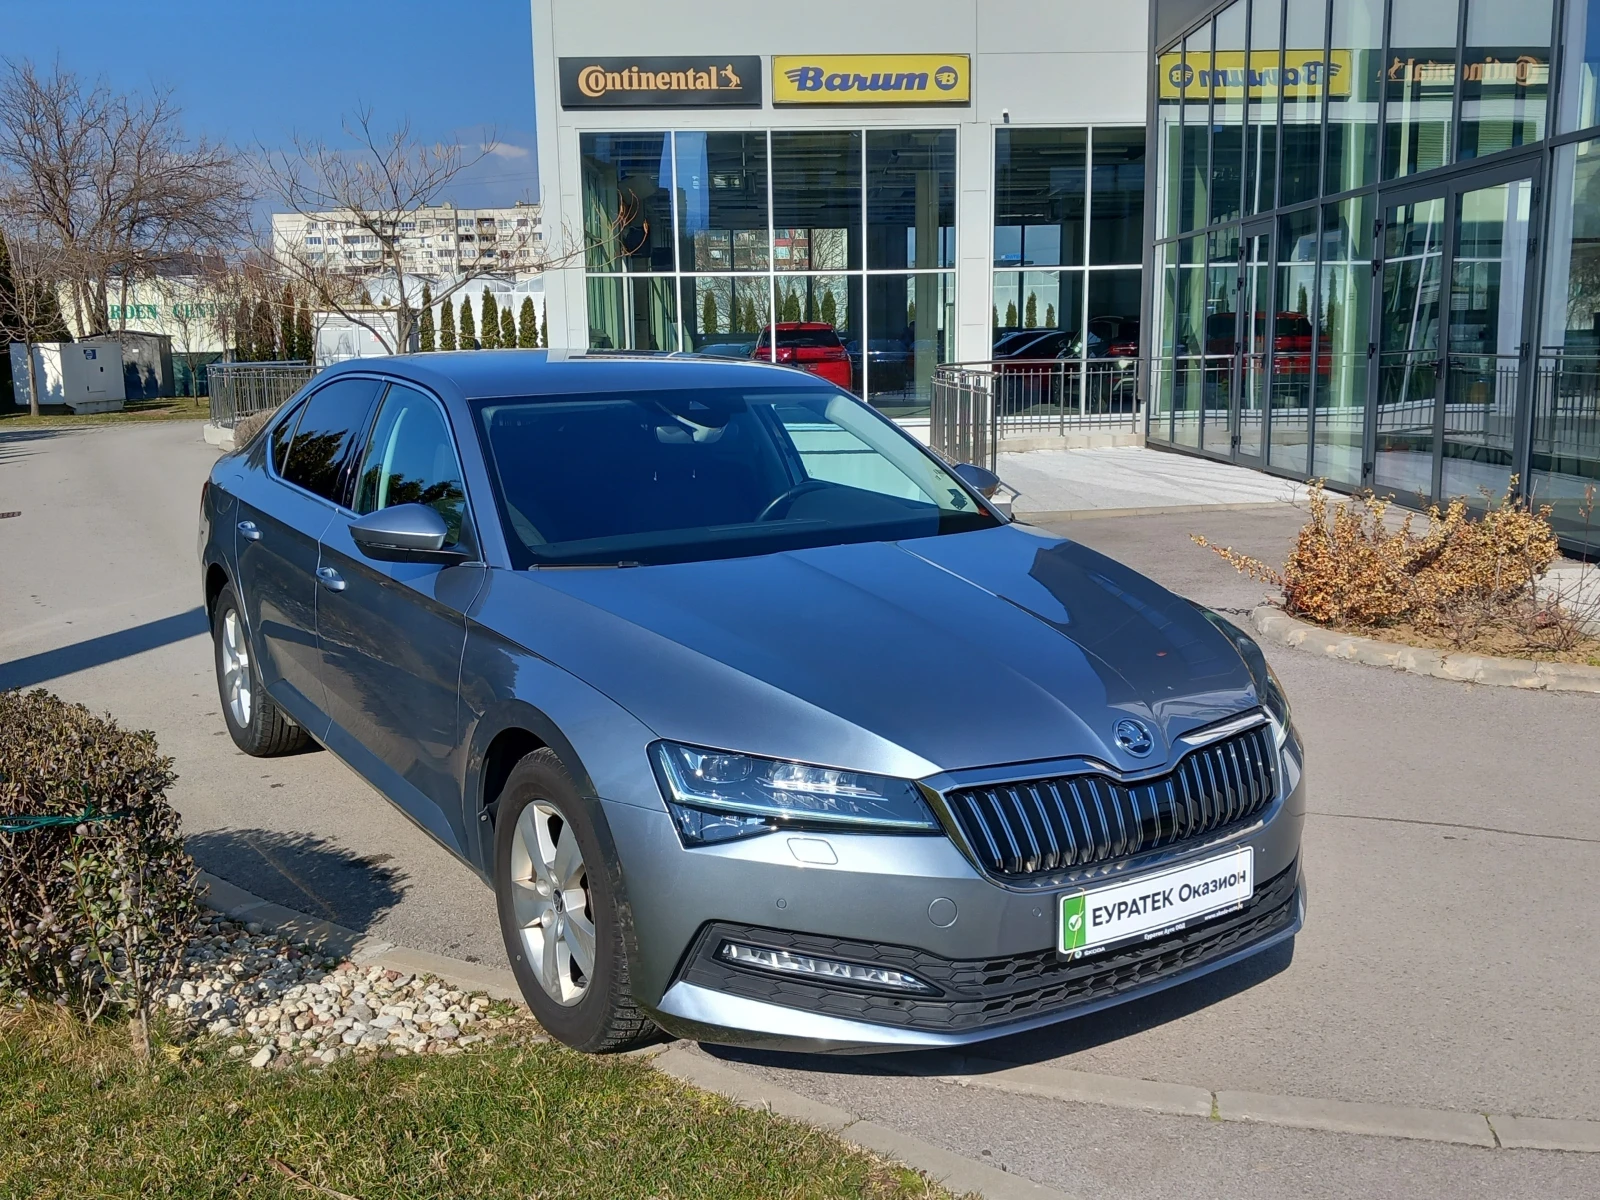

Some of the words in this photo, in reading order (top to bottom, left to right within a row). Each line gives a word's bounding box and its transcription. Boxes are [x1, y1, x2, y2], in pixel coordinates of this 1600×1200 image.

[578, 64, 719, 97] Continental
[784, 66, 929, 92] Barum
[1092, 887, 1174, 927] ЕУРАТЕК
[1178, 870, 1246, 903] Оказион
